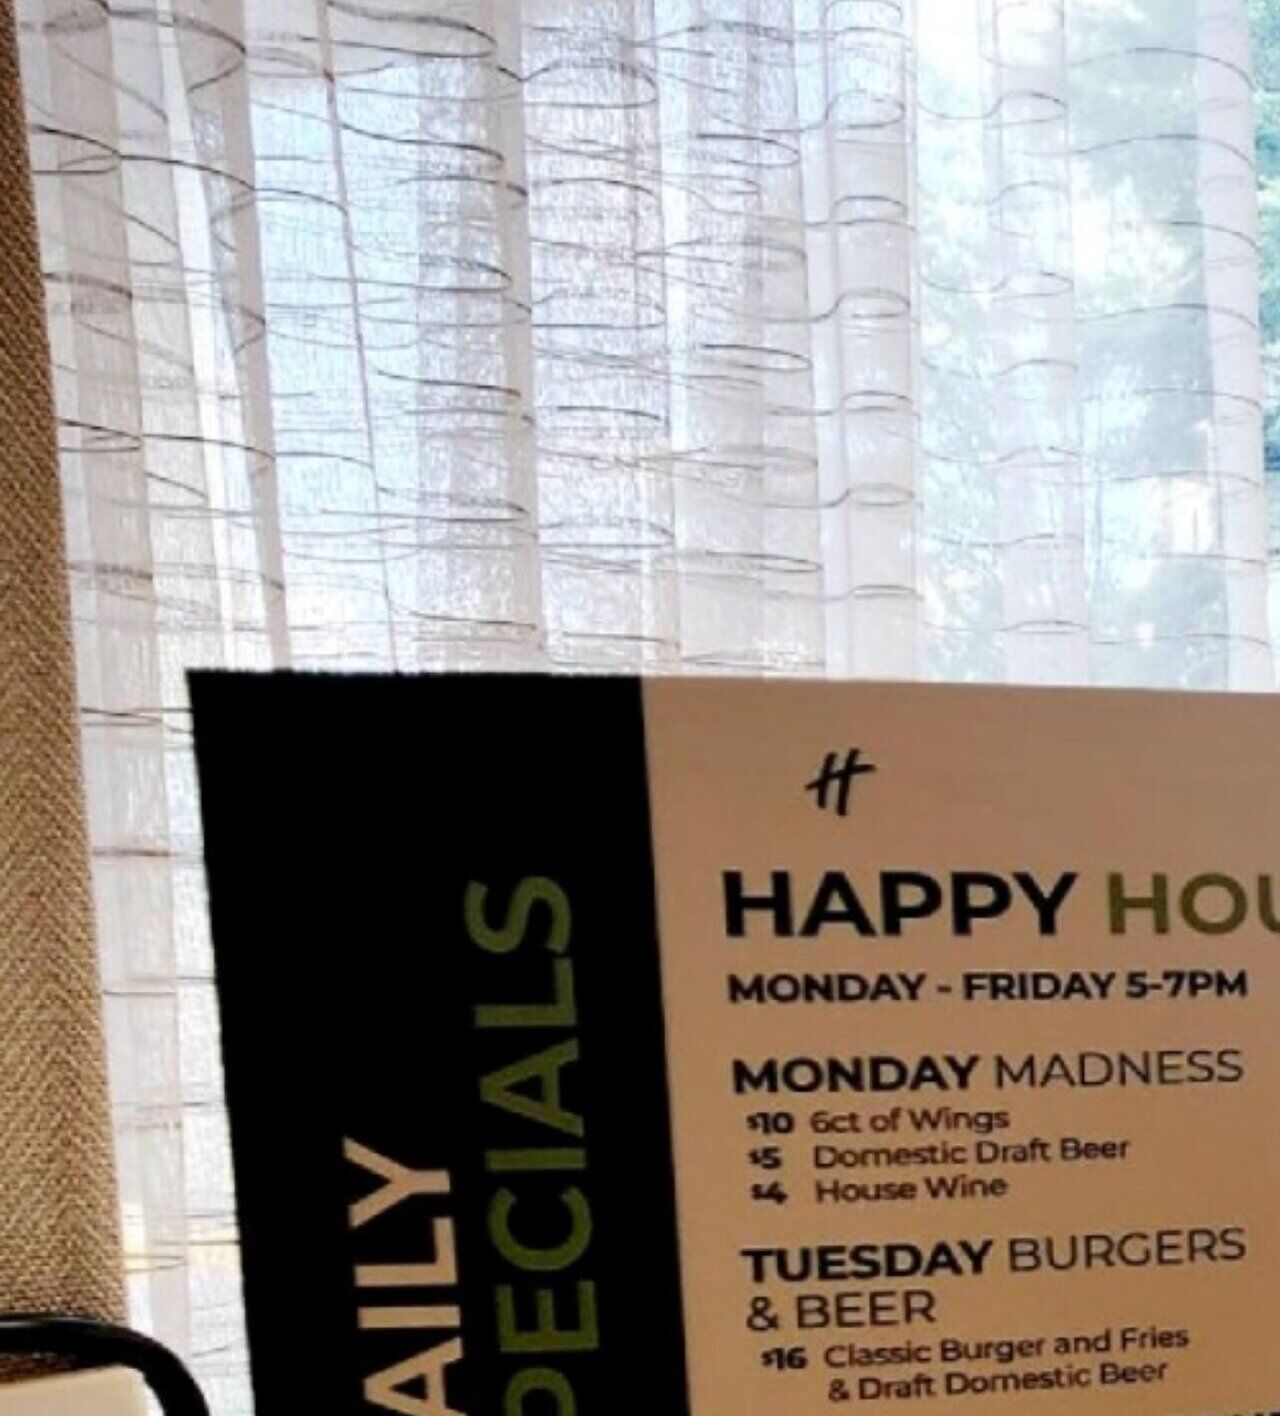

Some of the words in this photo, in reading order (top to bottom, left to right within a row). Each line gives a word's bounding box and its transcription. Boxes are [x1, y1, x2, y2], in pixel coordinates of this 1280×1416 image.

[722, 870, 1079, 938] HAPPY
[727, 972, 927, 1004] MONDAY
[962, 971, 1117, 1001] FRIDAY
[1125, 969, 1248, 999] 5-7PM
[732, 1054, 981, 1095] MONDAY
[994, 1048, 1245, 1090] MADNESS
[746, 1111, 796, 1136] $10
[809, 1109, 863, 1134] 6ct
[868, 1106, 903, 1134] of
[906, 1106, 1011, 1135] Wings
[747, 1146, 783, 1171] $5
[813, 1140, 968, 1170] Domestic
[974, 1137, 1053, 1165] Draft
[1059, 1137, 1130, 1162] Beer
[750, 1181, 789, 1205] $4
[814, 1179, 918, 1204] House
[923, 1173, 1009, 1200] Wine
[739, 1239, 994, 1284] TUESDAY
[1007, 1227, 1247, 1273] BURGERS
[746, 1295, 781, 1333] &
[795, 1289, 937, 1330] BEER
[761, 1346, 809, 1372] $16
[822, 1340, 932, 1369] Classic
[939, 1337, 1046, 1365] Burger
[1053, 1327, 1112, 1356] and
[1120, 1326, 1191, 1353] Fries
[827, 1378, 851, 1404] &
[858, 1372, 937, 1401] Draft
[944, 1364, 1092, 1396] Domestic
[1099, 1361, 1168, 1385] Beer
